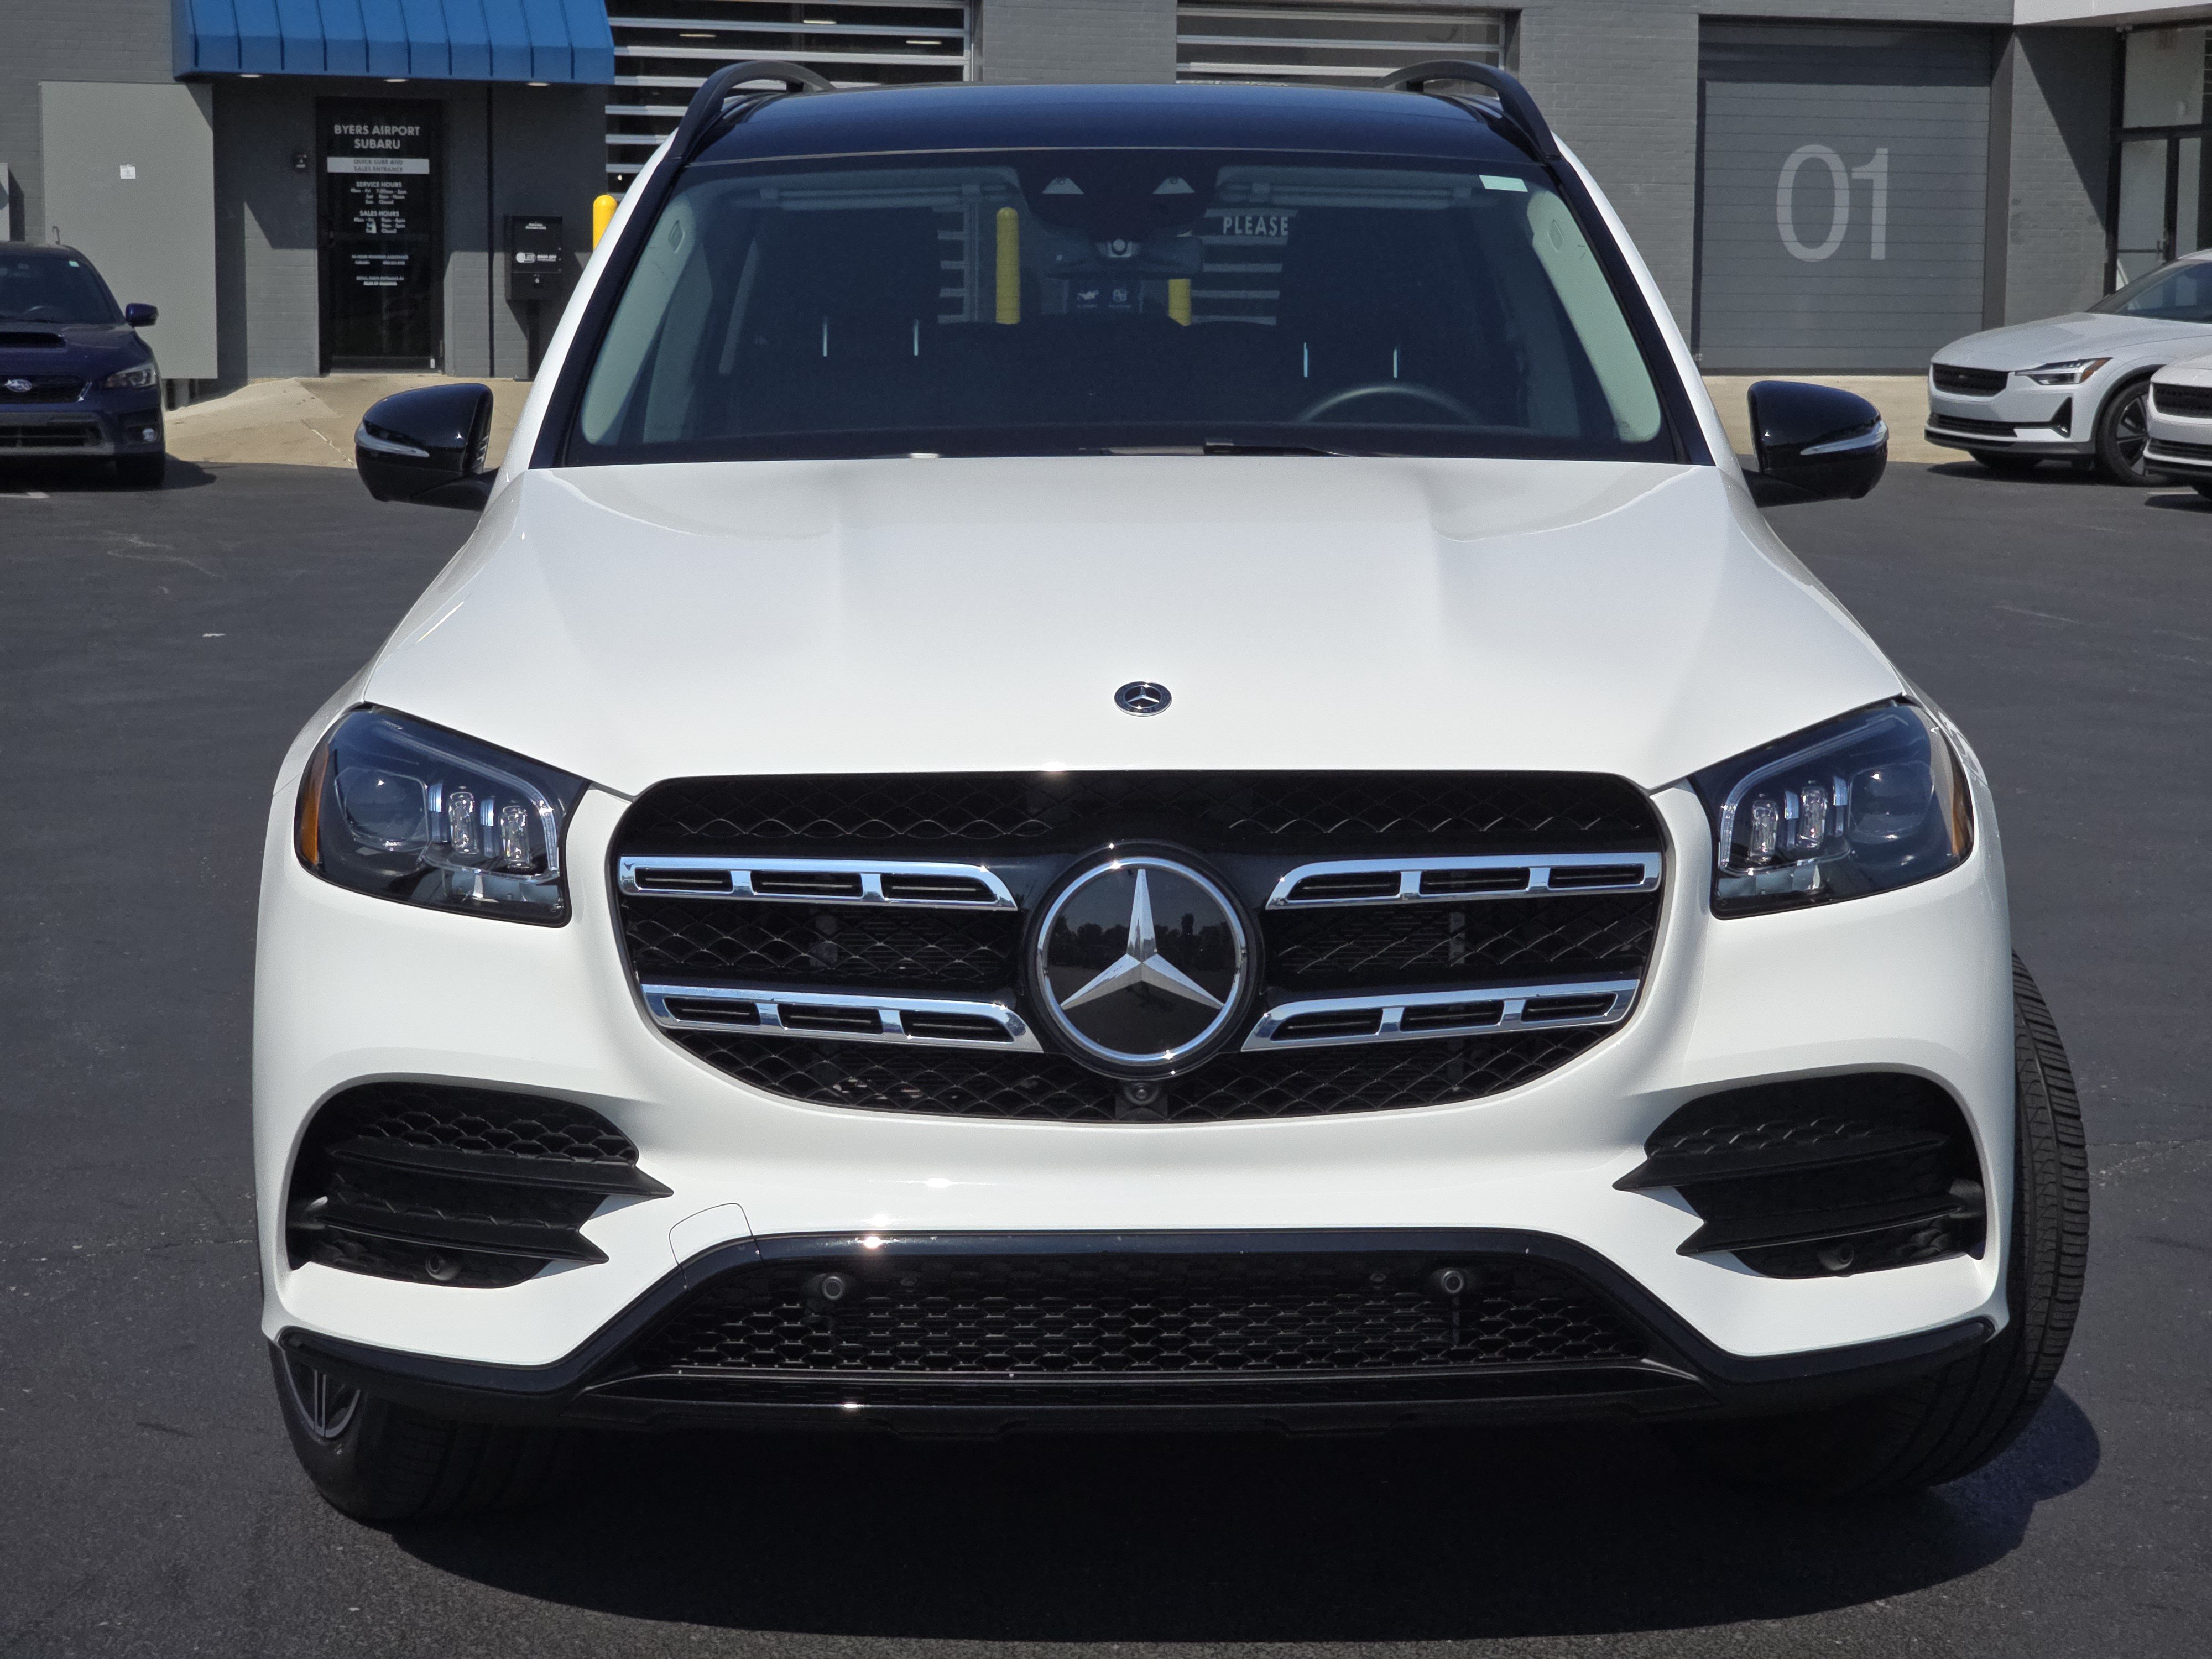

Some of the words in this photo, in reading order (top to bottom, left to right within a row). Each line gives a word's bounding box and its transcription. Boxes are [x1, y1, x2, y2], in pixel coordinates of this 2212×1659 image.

[334, 124, 369, 134] BYERS
[372, 125, 420, 136] AIRPORT
[354, 139, 400, 149] SUBARU
[1776, 144, 1888, 262] 01
[1223, 216, 1288, 236] PLEASE
